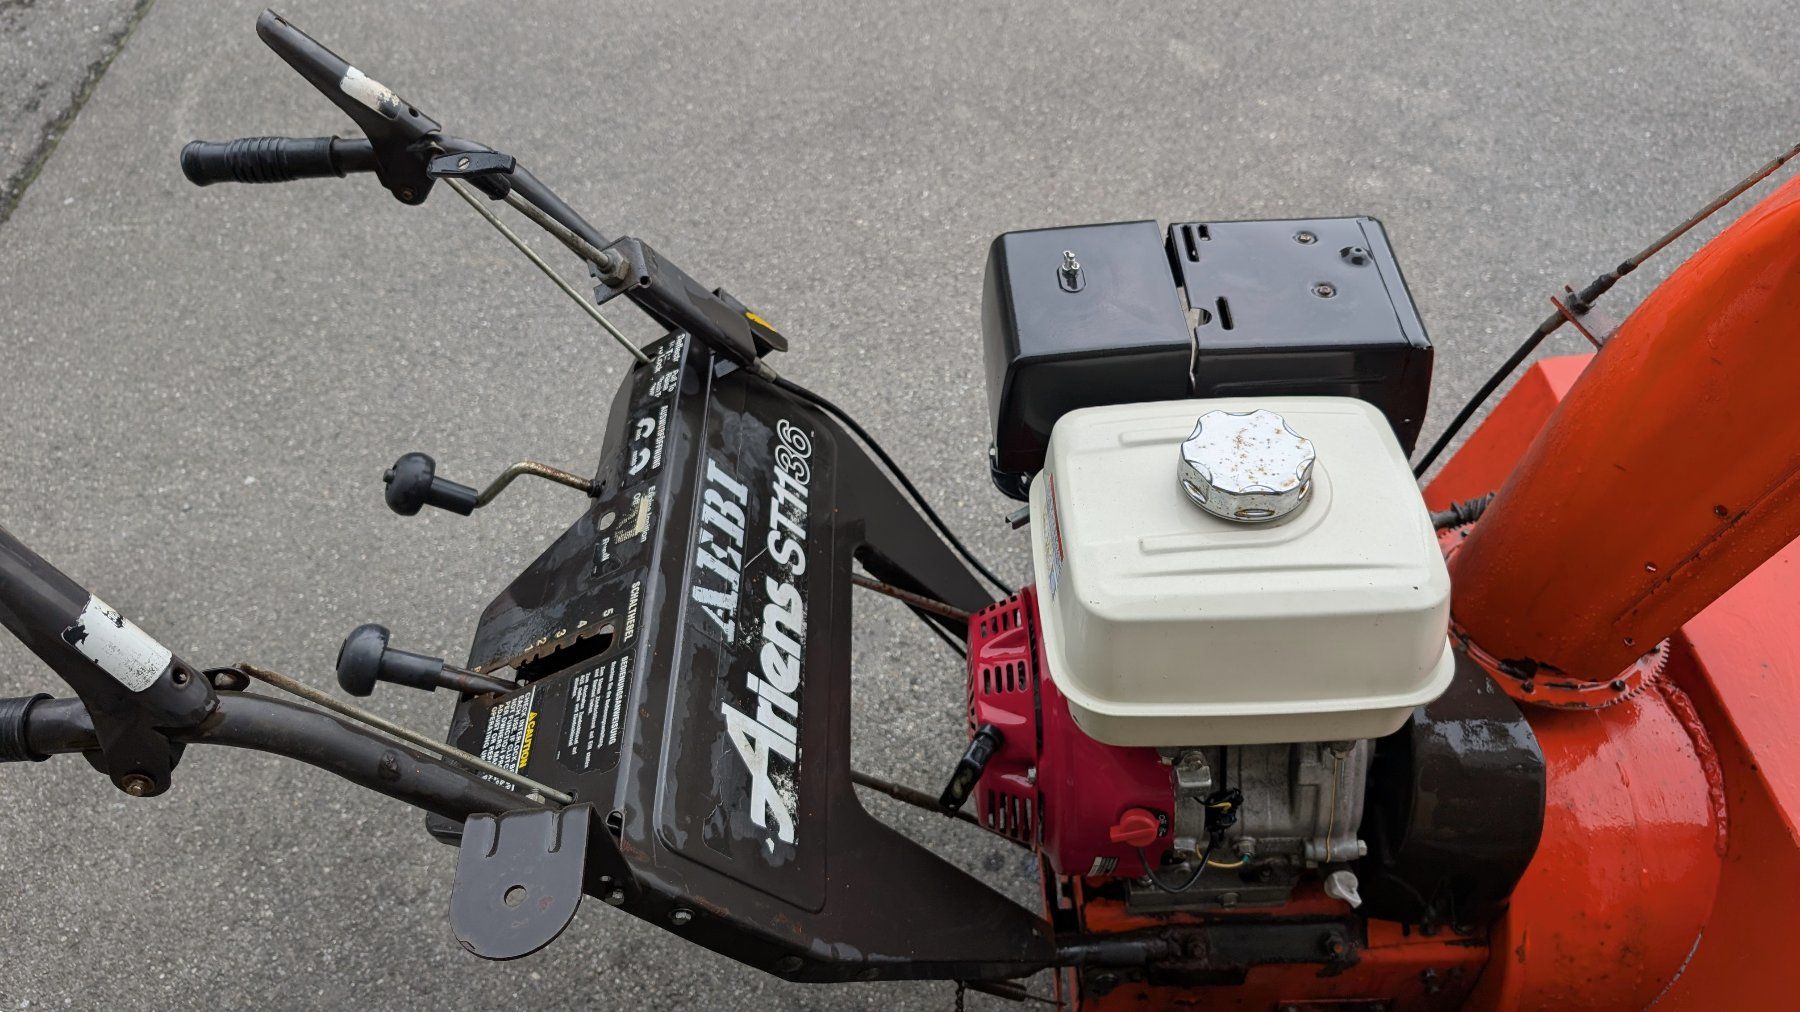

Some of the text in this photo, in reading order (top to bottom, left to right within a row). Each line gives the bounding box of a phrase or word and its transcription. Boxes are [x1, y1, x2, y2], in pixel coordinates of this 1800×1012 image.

[692, 458, 748, 644] AEBI
[577, 619, 588, 629] 4
[602, 607, 614, 617] 5
[623, 581, 641, 643] SCHALTHEBEL
[536, 637, 547, 646] 2
[555, 628, 567, 638] 3
[721, 418, 812, 845] Ariens ST1136
[503, 701, 511, 716] PER
[509, 698, 518, 714] NOT
[515, 694, 525, 716] EACH
[520, 692, 531, 718] CHECK
[608, 656, 629, 746] BEDIENUNGSANWEISUNG
[482, 706, 498, 749] OPERATING
[493, 704, 504, 731] ADJUST
[490, 732, 498, 745] OR
[495, 716, 508, 750] OWNERS
[500, 714, 514, 754] FUNCTION
[509, 734, 516, 743] IF
[511, 719, 525, 762] INTERLOCK
[519, 720, 536, 769] CAUTION
[503, 744, 514, 771] CLUTC
